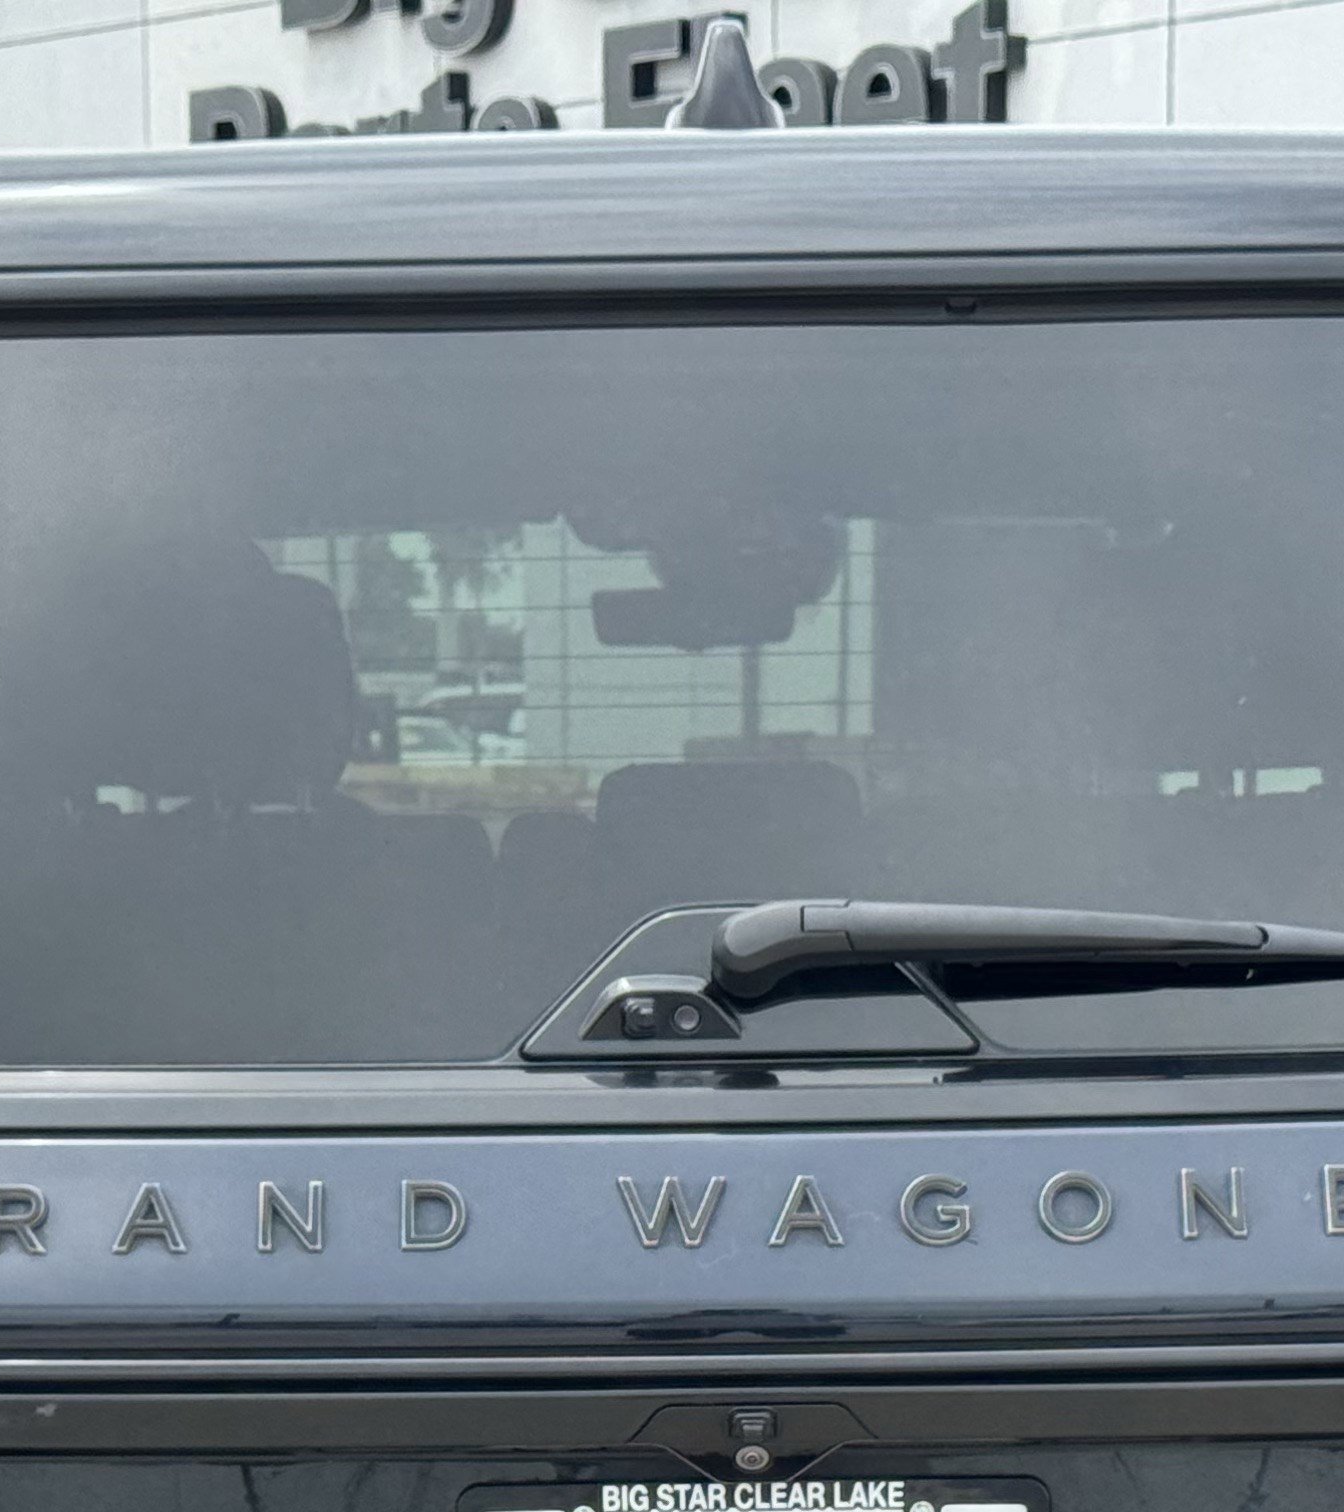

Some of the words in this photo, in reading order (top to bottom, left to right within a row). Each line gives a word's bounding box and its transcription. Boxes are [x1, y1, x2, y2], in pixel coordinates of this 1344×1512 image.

[602, 1486, 648, 1512] BIG
[656, 1484, 726, 1512] STAR
[734, 1482, 828, 1511] CLEAR
[833, 1480, 905, 1510] LAKE
